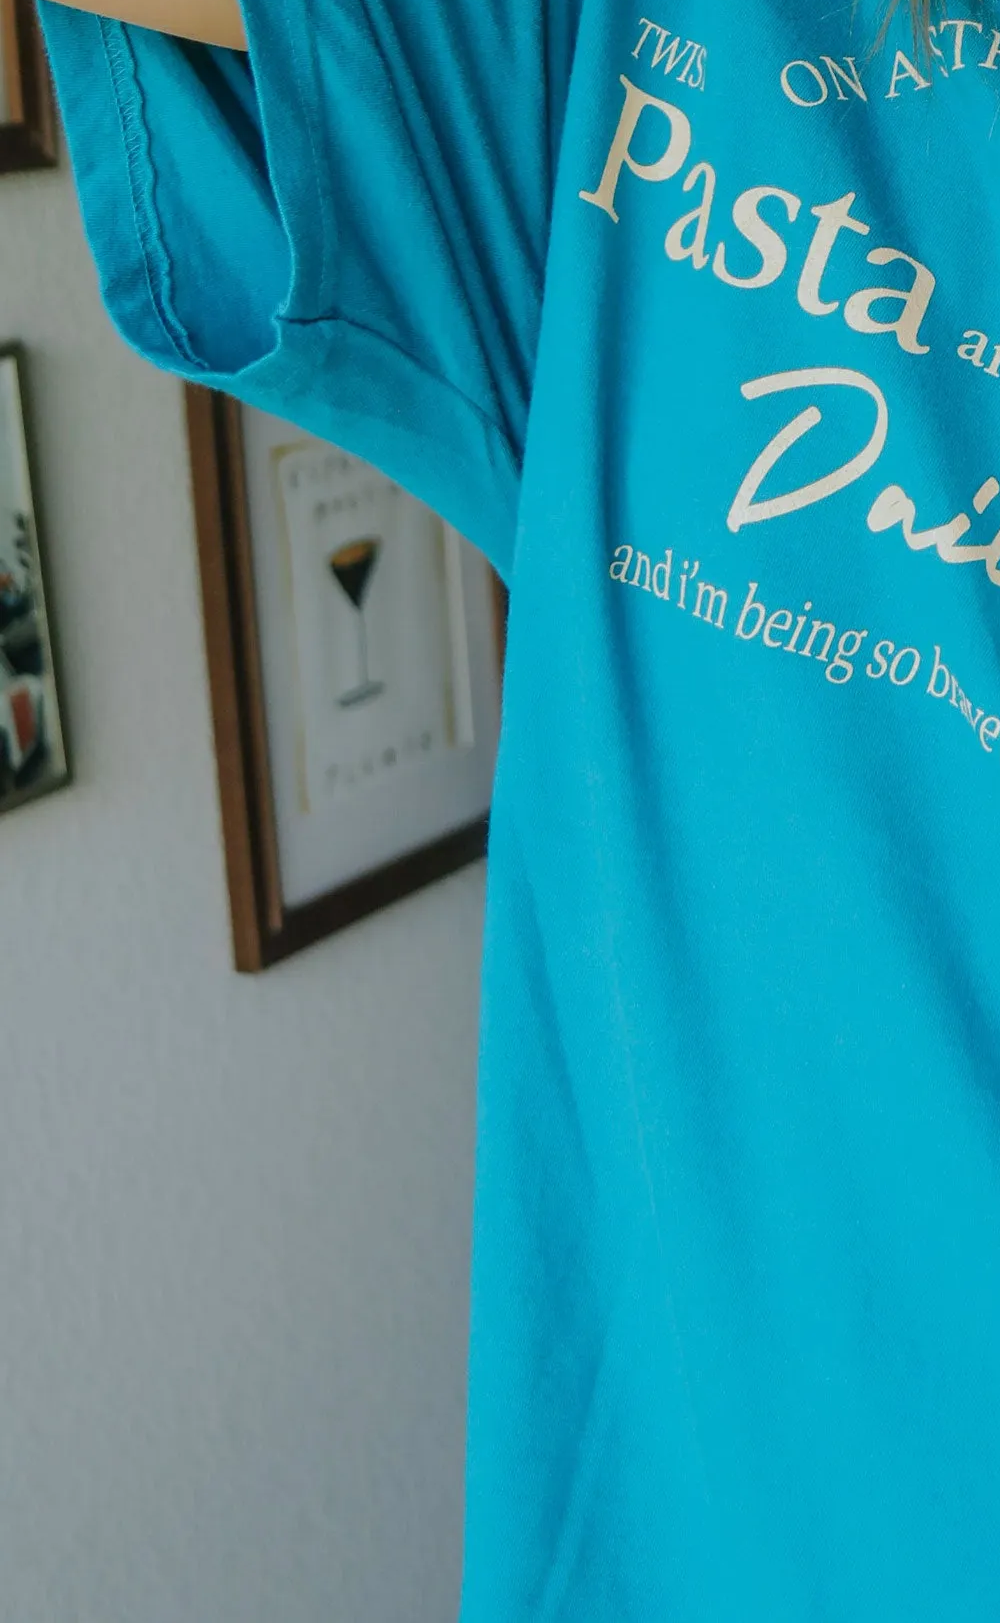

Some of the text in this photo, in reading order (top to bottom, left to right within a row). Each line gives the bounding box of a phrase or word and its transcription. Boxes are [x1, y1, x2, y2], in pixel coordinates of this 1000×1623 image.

[631, 17, 707, 92] TWIS
[780, 57, 867, 107] ON
[885, 50, 932, 98] A
[579, 74, 936, 355] Pasta
[609, 545, 673, 601] and
[677, 560, 728, 629] i'm
[735, 582, 869, 684] being
[865, 640, 921, 686] so
